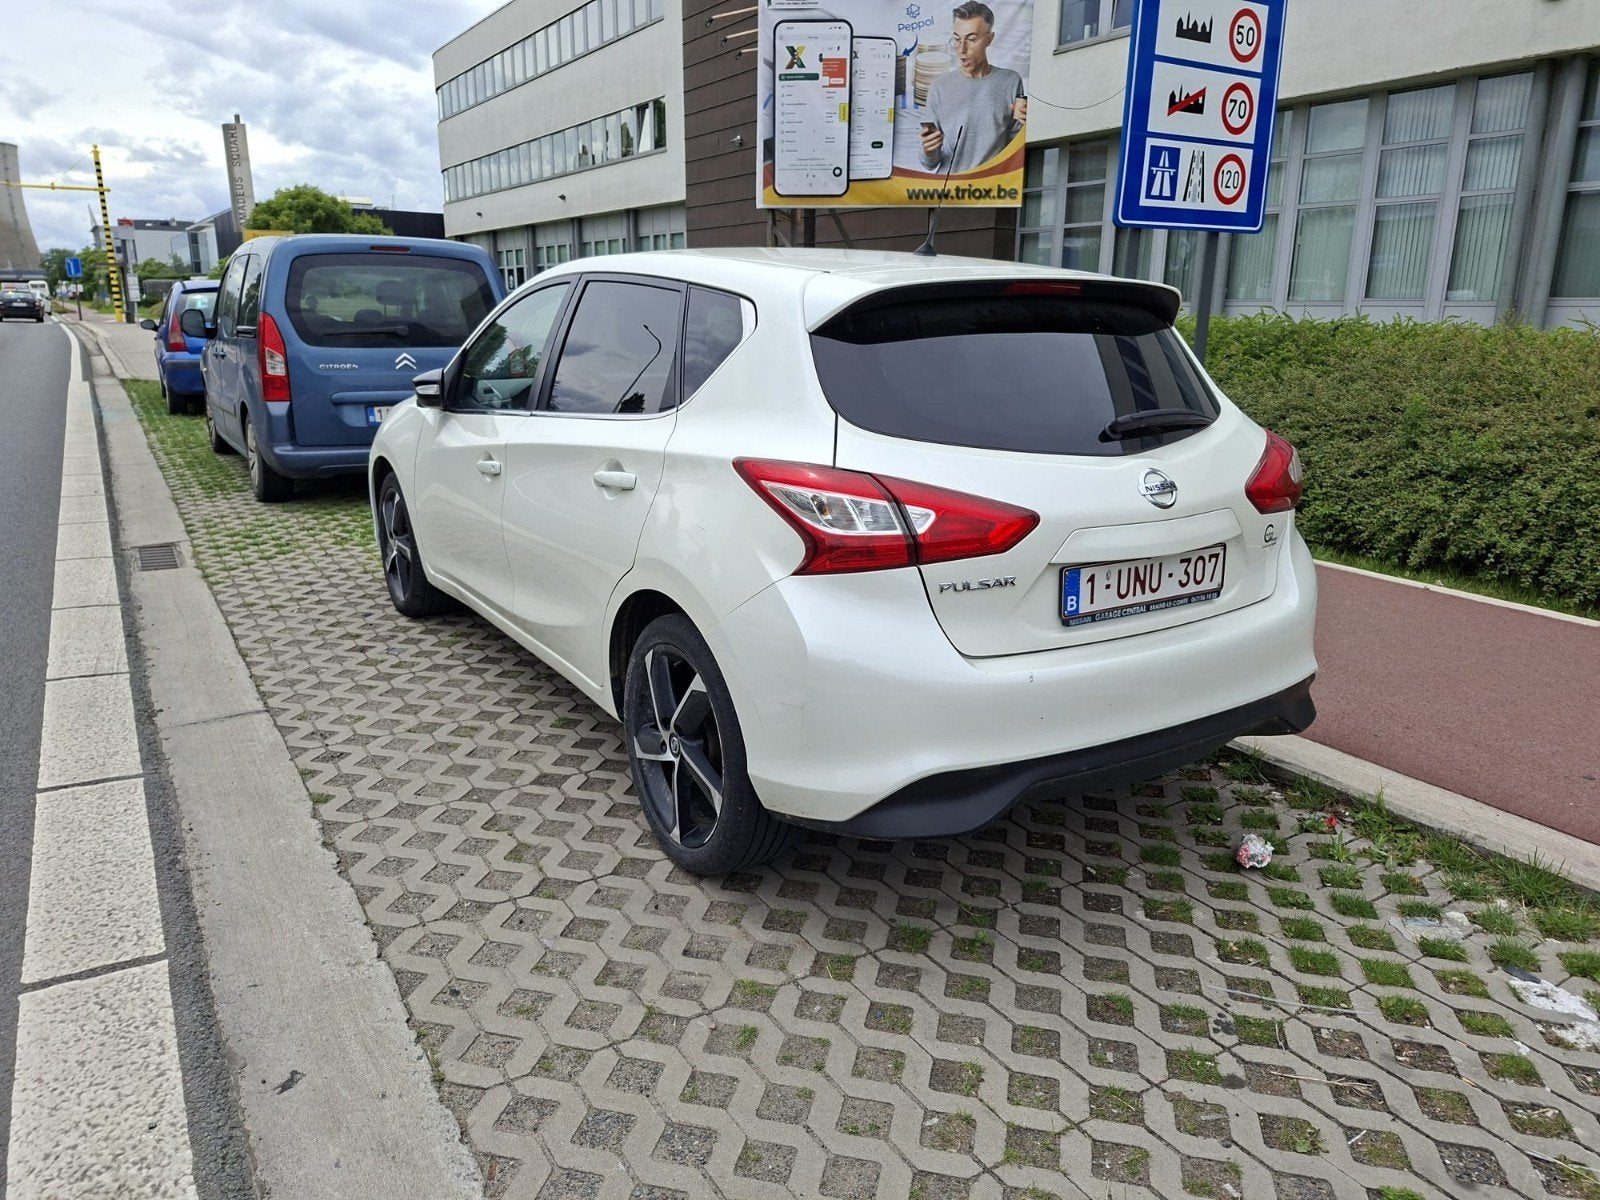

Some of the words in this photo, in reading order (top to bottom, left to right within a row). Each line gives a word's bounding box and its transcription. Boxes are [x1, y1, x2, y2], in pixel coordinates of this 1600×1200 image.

[1235, 24, 1256, 47] 50
[1228, 98, 1248, 120] 70
[227, 124, 242, 168] SQUARE
[1220, 169, 1240, 190] 120
[905, 183, 1019, 201] www.triox.be
[368, 415, 375, 423] B
[1144, 481, 1176, 492] NISSAN
[939, 575, 1017, 594] PULSAR
[1066, 595, 1077, 612] B
[1095, 609, 1121, 621] GARAGE
[1121, 605, 1147, 616] CENTRAL
